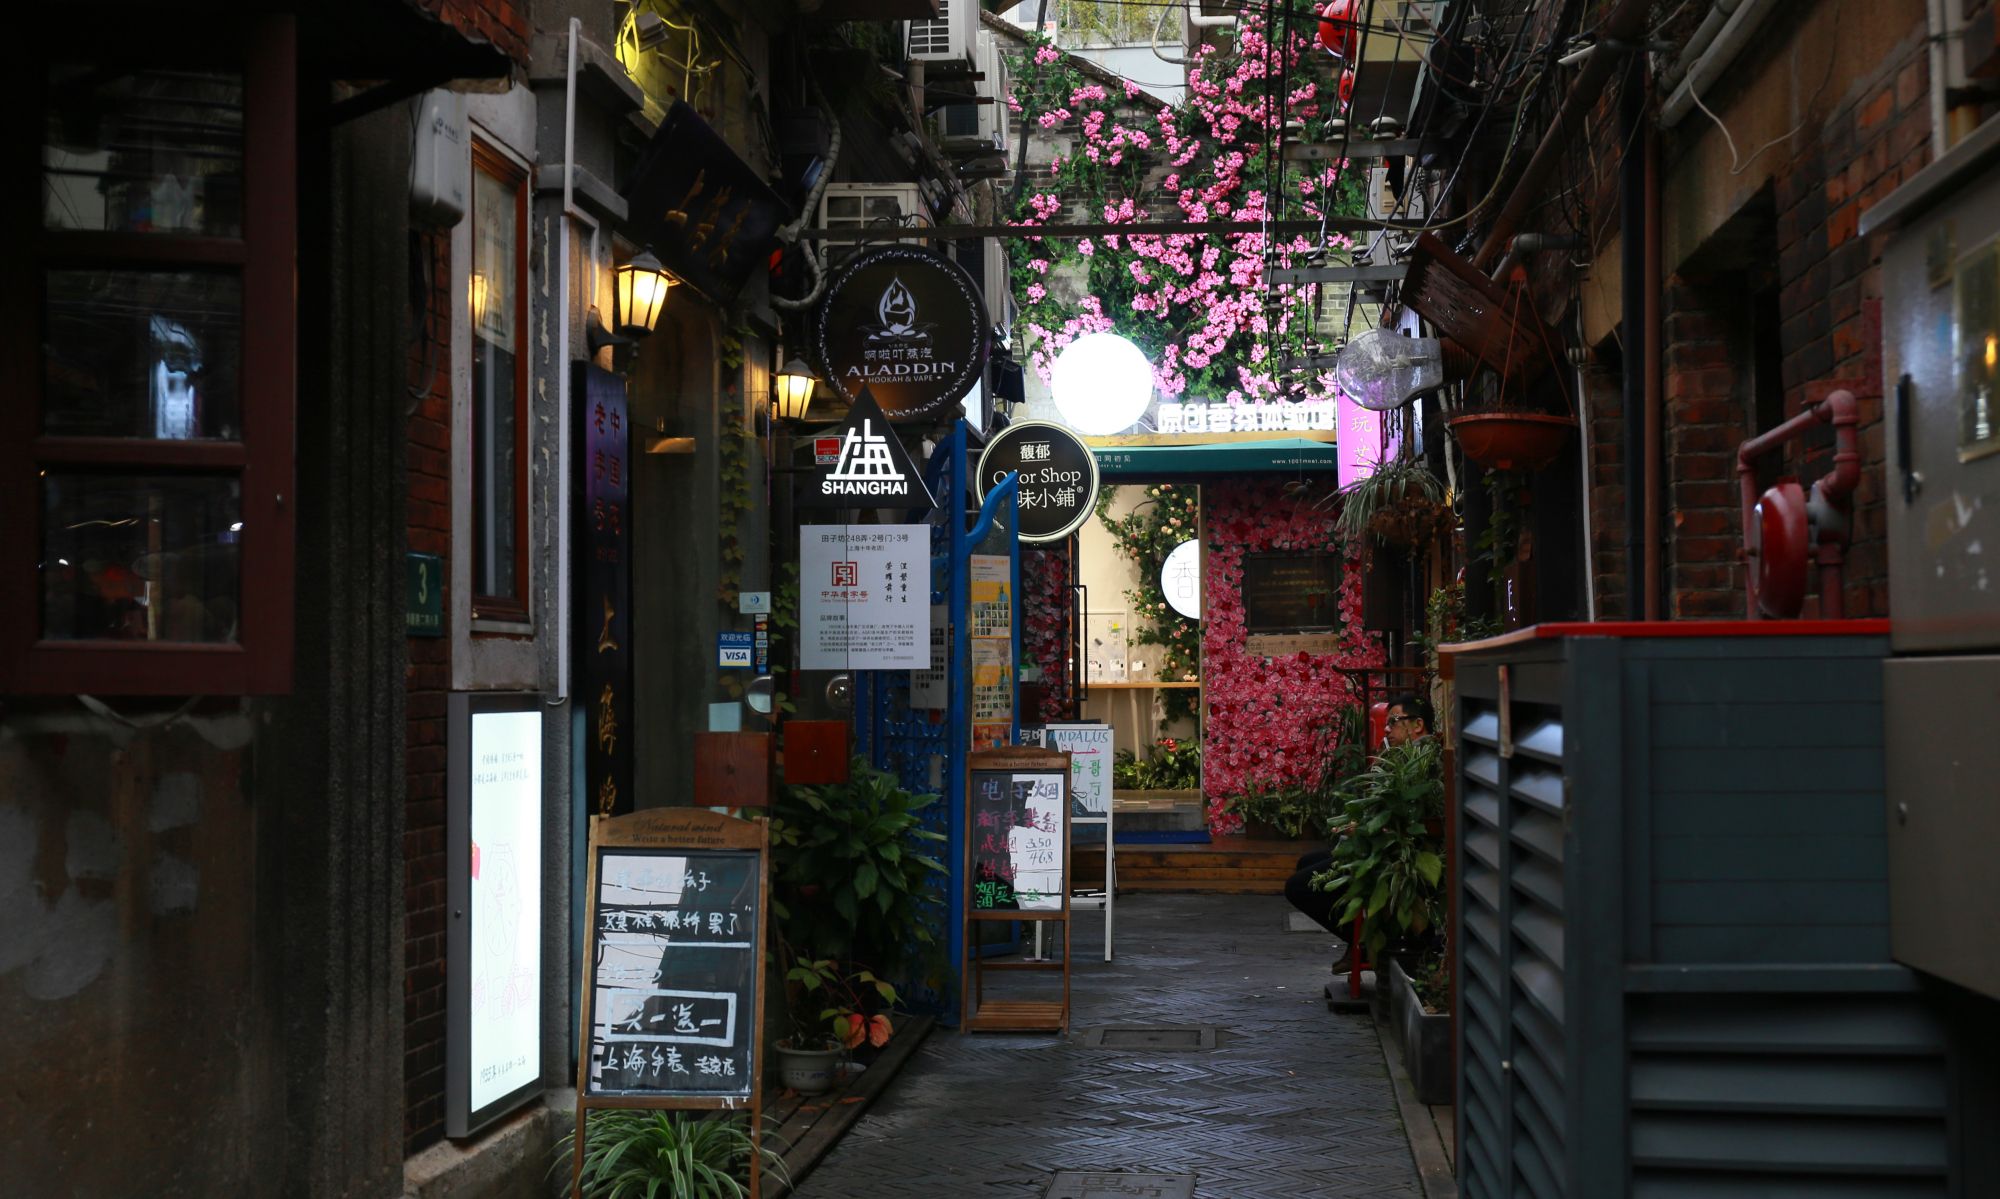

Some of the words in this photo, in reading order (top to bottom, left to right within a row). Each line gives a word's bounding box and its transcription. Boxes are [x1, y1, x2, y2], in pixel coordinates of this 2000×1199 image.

[845, 361, 956, 378] ALADDIN
[868, 375, 903, 384] HOOKAH
[905, 375, 912, 383] &
[913, 374, 933, 383] VAPE
[1020, 444, 1050, 460] 馥郁
[993, 469, 1037, 486] Oor
[1041, 467, 1082, 487] Shop
[821, 481, 908, 496] SHANGHAI
[418, 562, 428, 605] 3
[720, 633, 751, 642] 欢迎光临
[725, 651, 747, 660] VISA
[980, 778, 1059, 801] 电子烟
[668, 834, 695, 844] better
[697, 835, 725, 845] future
[601, 1043, 690, 1078] 上海手表
